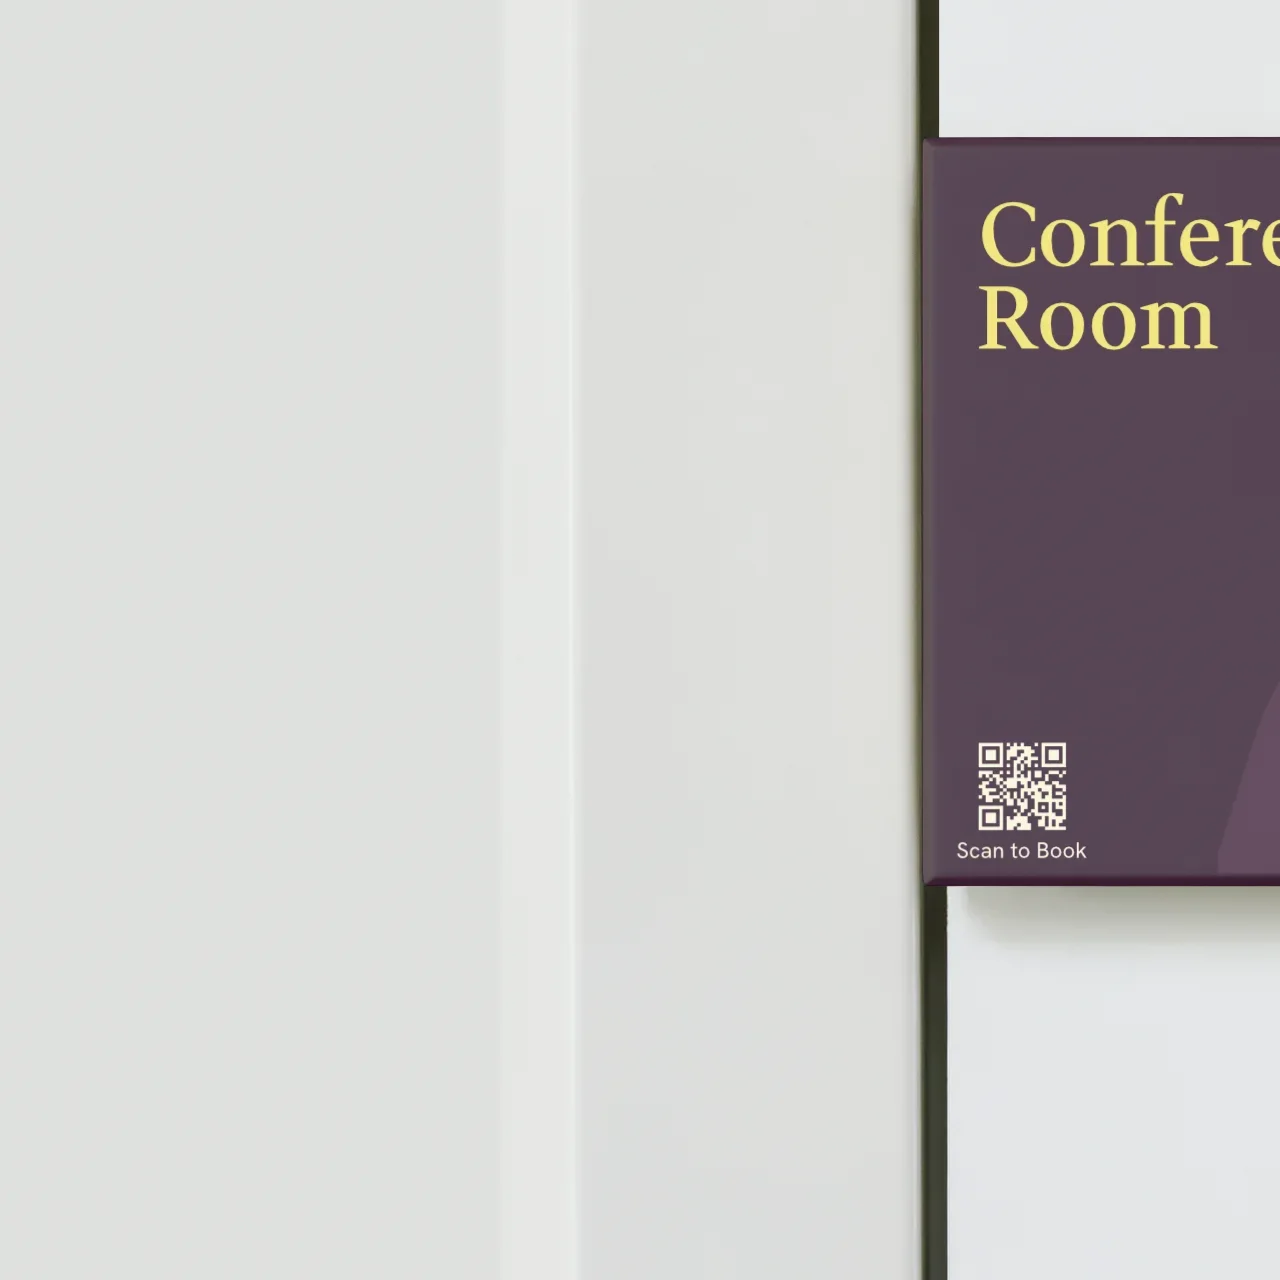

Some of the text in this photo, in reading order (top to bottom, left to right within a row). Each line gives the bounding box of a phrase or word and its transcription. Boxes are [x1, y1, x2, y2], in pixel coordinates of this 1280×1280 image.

[978, 285, 1219, 351] Room
[956, 841, 1087, 859] Scan to Book
